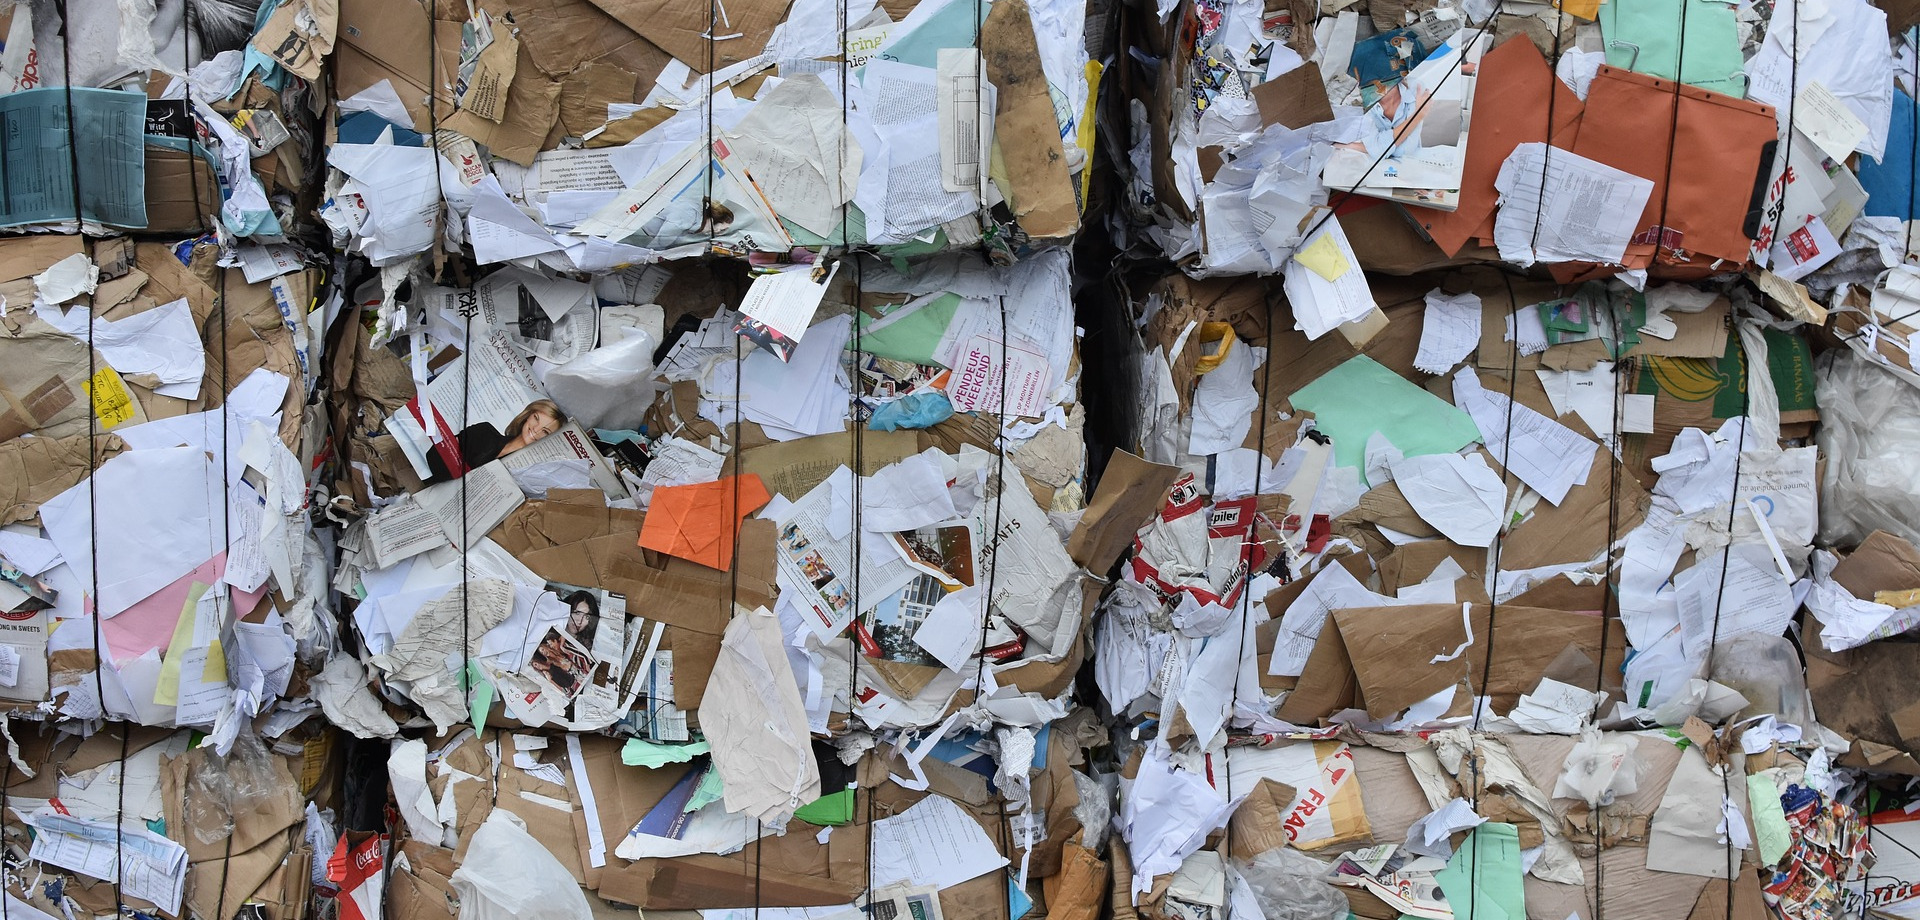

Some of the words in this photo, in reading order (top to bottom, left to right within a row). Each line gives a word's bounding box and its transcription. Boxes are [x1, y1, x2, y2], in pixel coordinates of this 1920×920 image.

[489, 335, 518, 374] SUCCESS
[495, 329, 527, 373] STRATEGY
[525, 373, 538, 392] FOR
[964, 355, 991, 411] WEEKEND
[1020, 371, 1032, 403] MONTUREN
[1025, 369, 1040, 409] ZONNEBRILLEN
[11, 624, 18, 632] IN
[18, 625, 41, 633] SWEETS
